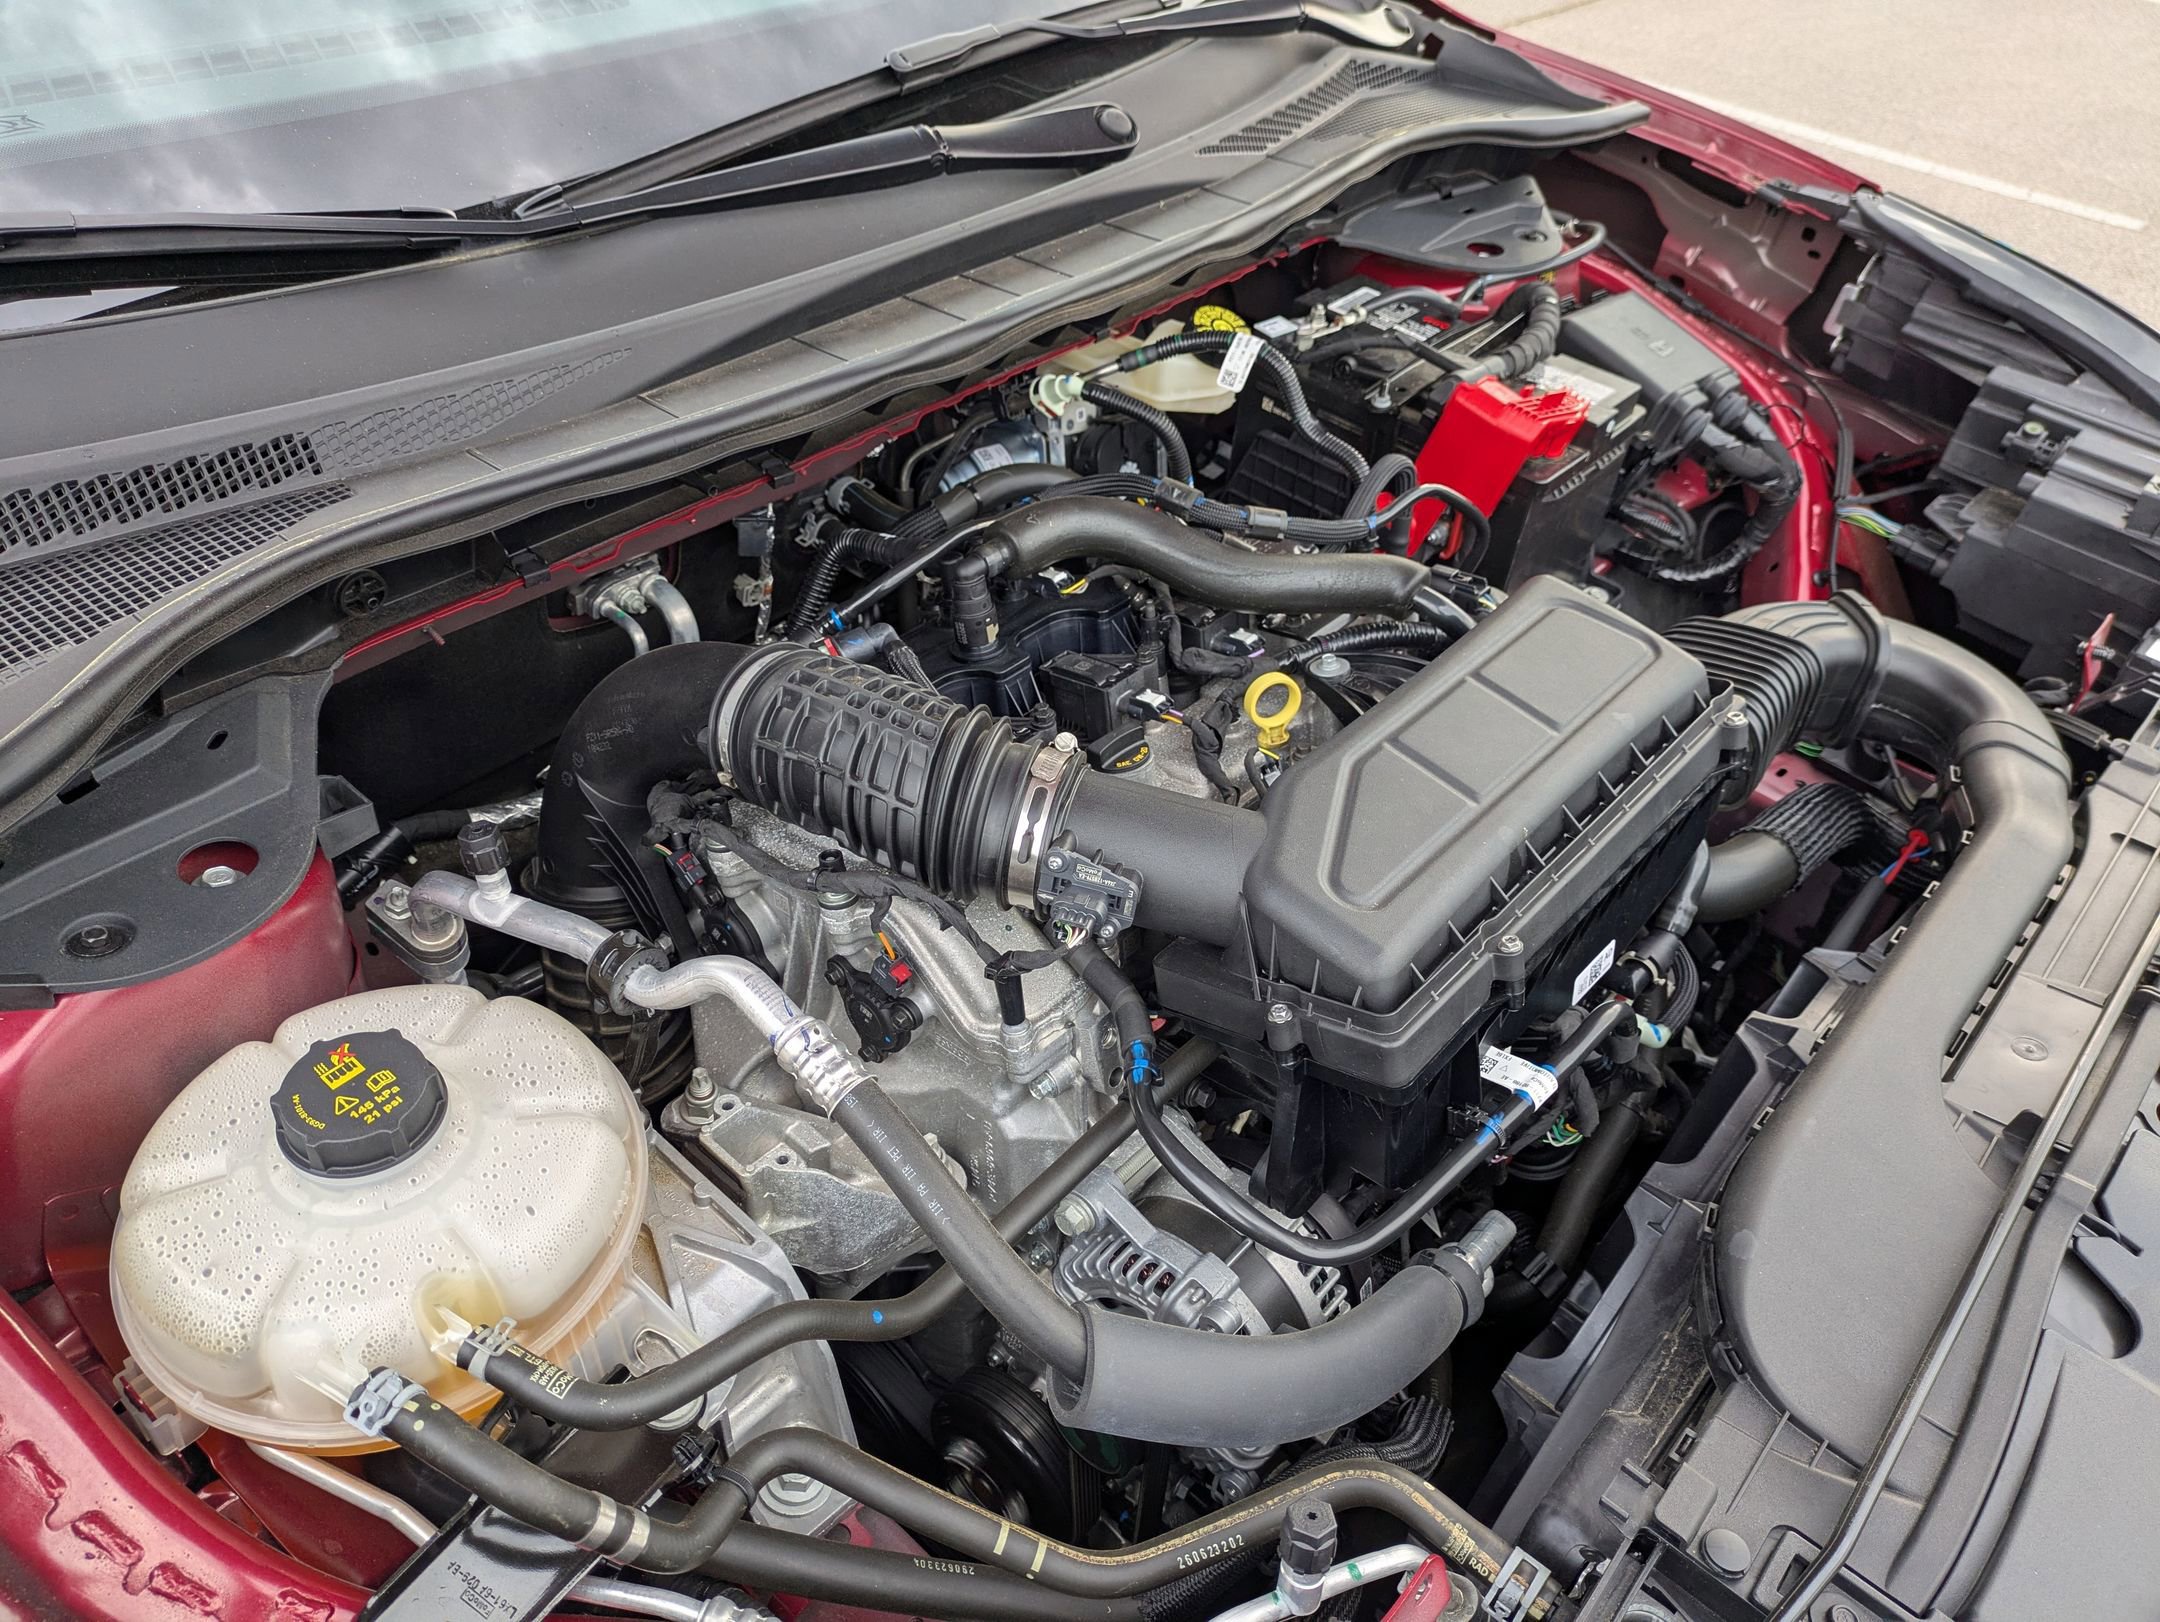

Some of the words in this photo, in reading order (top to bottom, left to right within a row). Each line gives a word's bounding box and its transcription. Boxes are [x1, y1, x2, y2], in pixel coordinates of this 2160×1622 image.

[350, 1100, 375, 1119] 145
[374, 1085, 401, 1104] kPa
[363, 1109, 382, 1125] 21
[382, 1095, 404, 1114] psi
[886, 1145, 903, 1162] PET
[916, 1182, 929, 1198] PA
[552, 1375, 575, 1394] MoCo
[1177, 1533, 1245, 1570] 260623202
[1468, 1556, 1489, 1577] RAD
